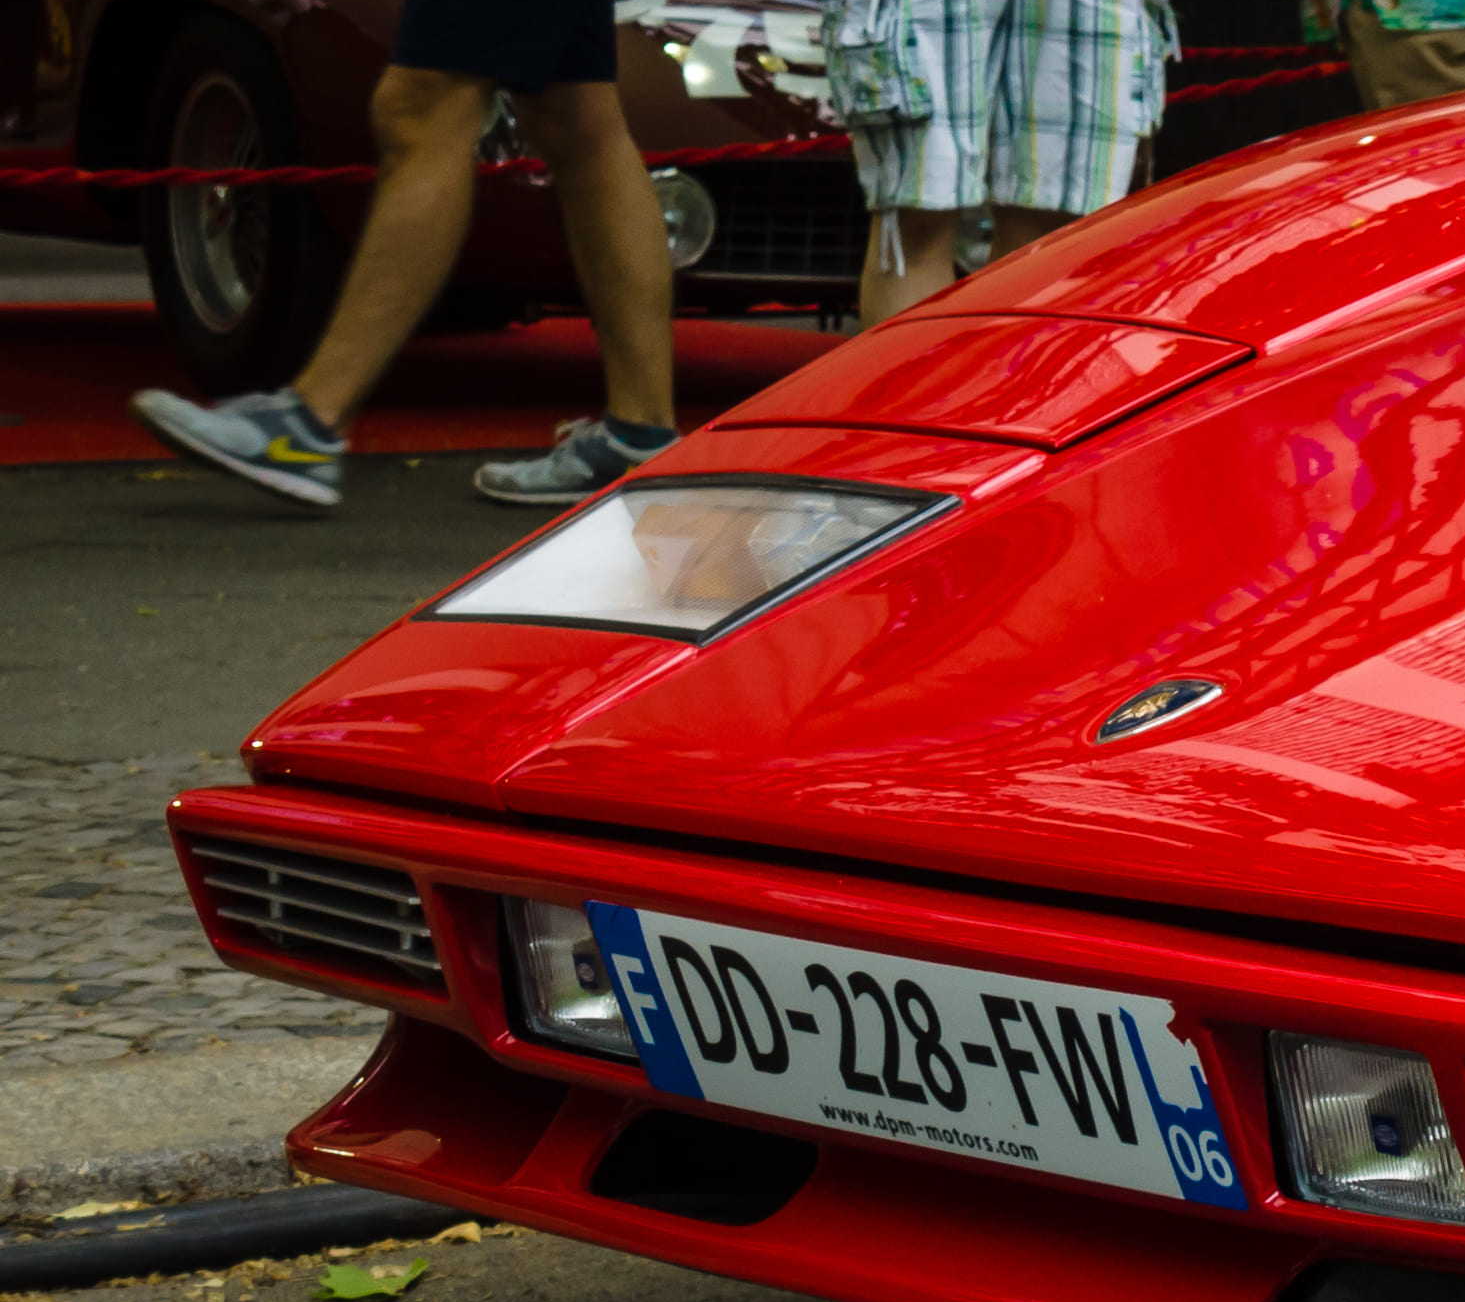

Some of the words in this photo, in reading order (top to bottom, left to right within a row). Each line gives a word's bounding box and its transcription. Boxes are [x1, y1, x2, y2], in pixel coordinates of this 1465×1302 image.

[611, 952, 657, 1046] F
[659, 935, 1139, 1146] DD-228-FW
[819, 1103, 1039, 1162] www.dpm-motors.com
[1168, 1123, 1234, 1188] 06
